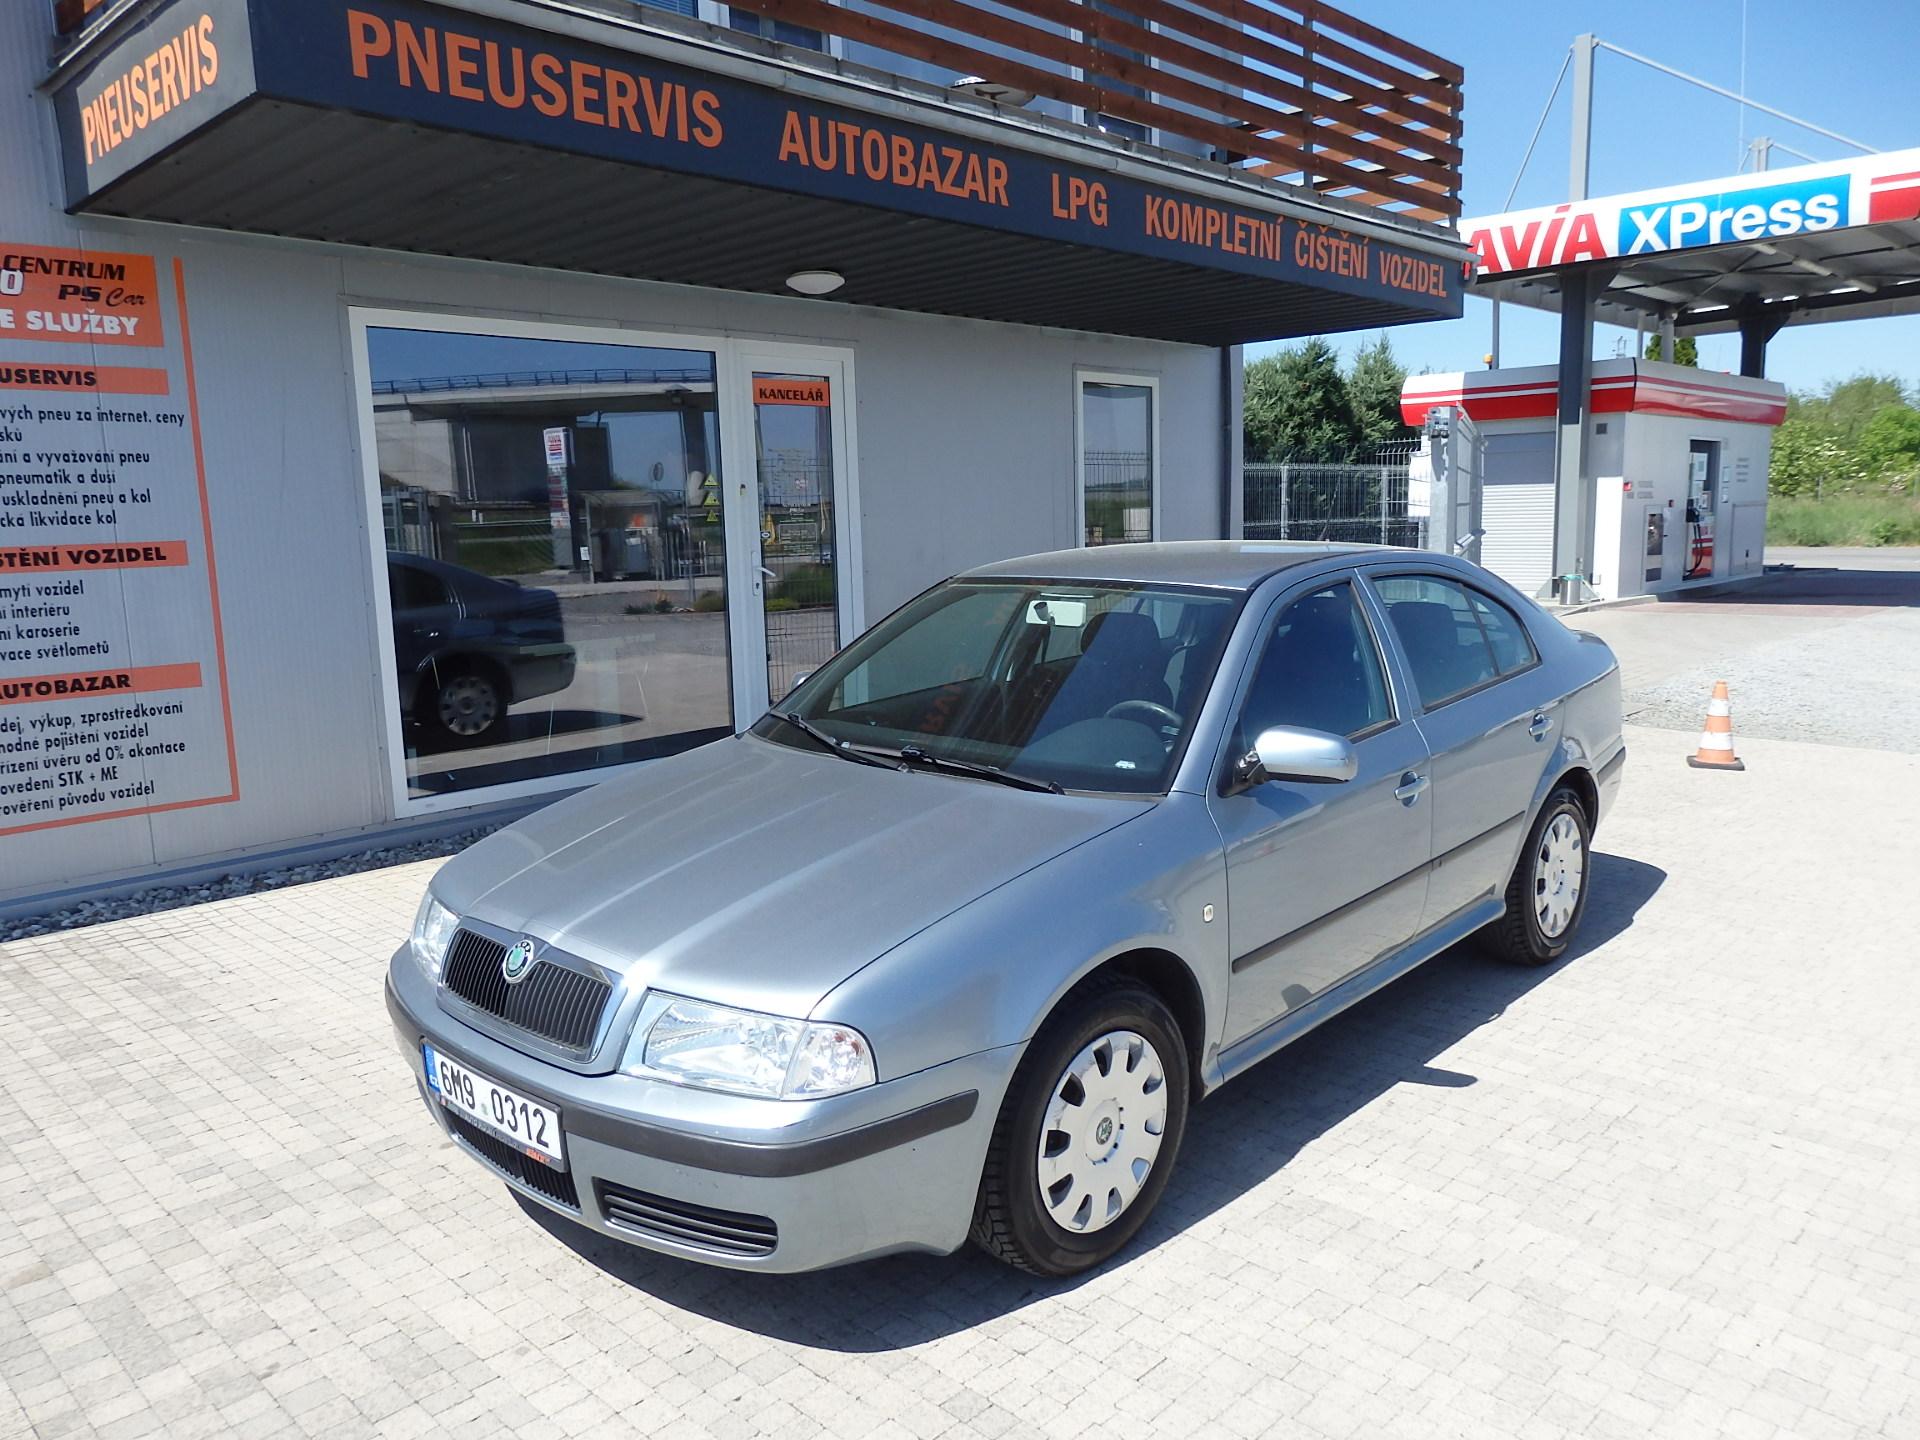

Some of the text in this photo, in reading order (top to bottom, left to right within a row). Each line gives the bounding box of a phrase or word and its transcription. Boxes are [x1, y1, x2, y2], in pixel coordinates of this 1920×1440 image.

[81, 14, 218, 166] PNEUSERVIS
[347, 9, 1447, 298] PNEUSERVIS AUTOBAZAR LPG KOMPLETNÍ ČIŠTĚNÍ VOZIDEL
[1627, 193, 1839, 256] XPress
[3, 254, 125, 281] CENTRUM
[58, 284, 102, 302] PS
[105, 288, 146, 307] Car
[26, 308, 139, 336] SLUŽBY
[759, 388, 824, 401] KANCELÁŘ
[38, 410, 71, 424] pneu
[76, 411, 92, 421] za
[156, 413, 184, 427] ceny
[23, 453, 31, 463] a
[37, 450, 114, 467] vyvažování
[119, 453, 150, 467] pneu
[77, 474, 85, 484] a
[82, 494, 114, 508] pneu
[119, 494, 126, 503] a
[131, 488, 151, 503] kol
[30, 510, 92, 526] likvidace
[96, 509, 117, 524] kol
[67, 547, 166, 565] VOZIDEL
[36, 579, 84, 596] vozidel
[11, 603, 70, 618] interiéru
[16, 622, 80, 639] karoserie
[38, 641, 109, 658] světlometů
[81, 702, 183, 726] zprostředkování
[45, 730, 99, 751] pojištění
[104, 722, 148, 741] vozidel
[86, 748, 100, 763] od
[105, 745, 124, 761] 0%
[129, 742, 186, 758] akontace
[58, 770, 84, 788] STK
[101, 766, 119, 782] ME
[59, 788, 105, 811] původu
[110, 780, 155, 800] vozidel
[440, 1061, 475, 1110] 6M9
[491, 1088, 549, 1149] 0312
